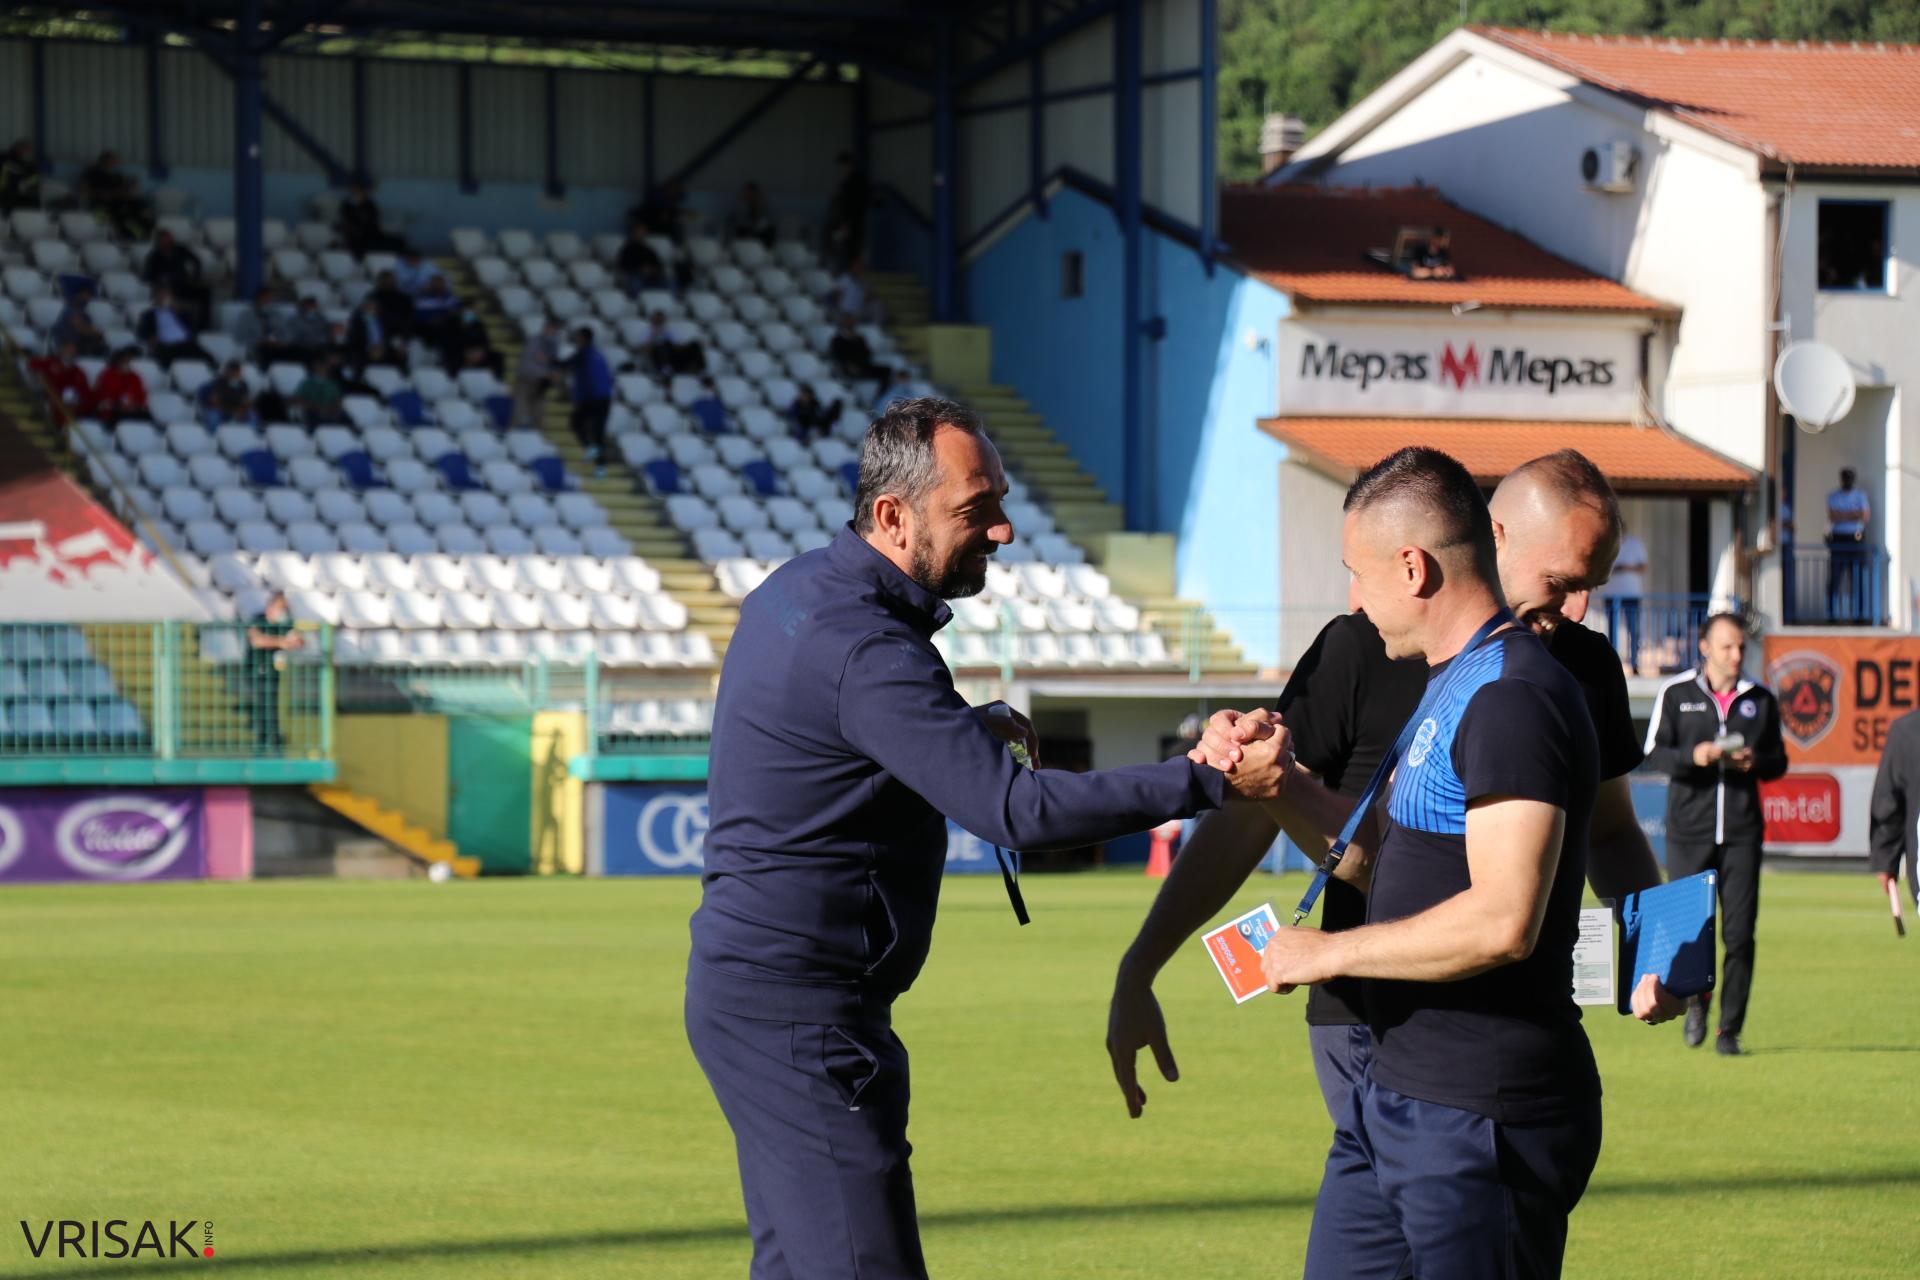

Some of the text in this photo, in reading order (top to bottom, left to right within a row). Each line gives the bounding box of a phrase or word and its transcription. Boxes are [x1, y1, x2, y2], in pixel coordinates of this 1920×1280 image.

[1300, 343, 1429, 390] Mepas
[1488, 348, 1614, 395] Mepas
[1855, 658, 1920, 708] DE
